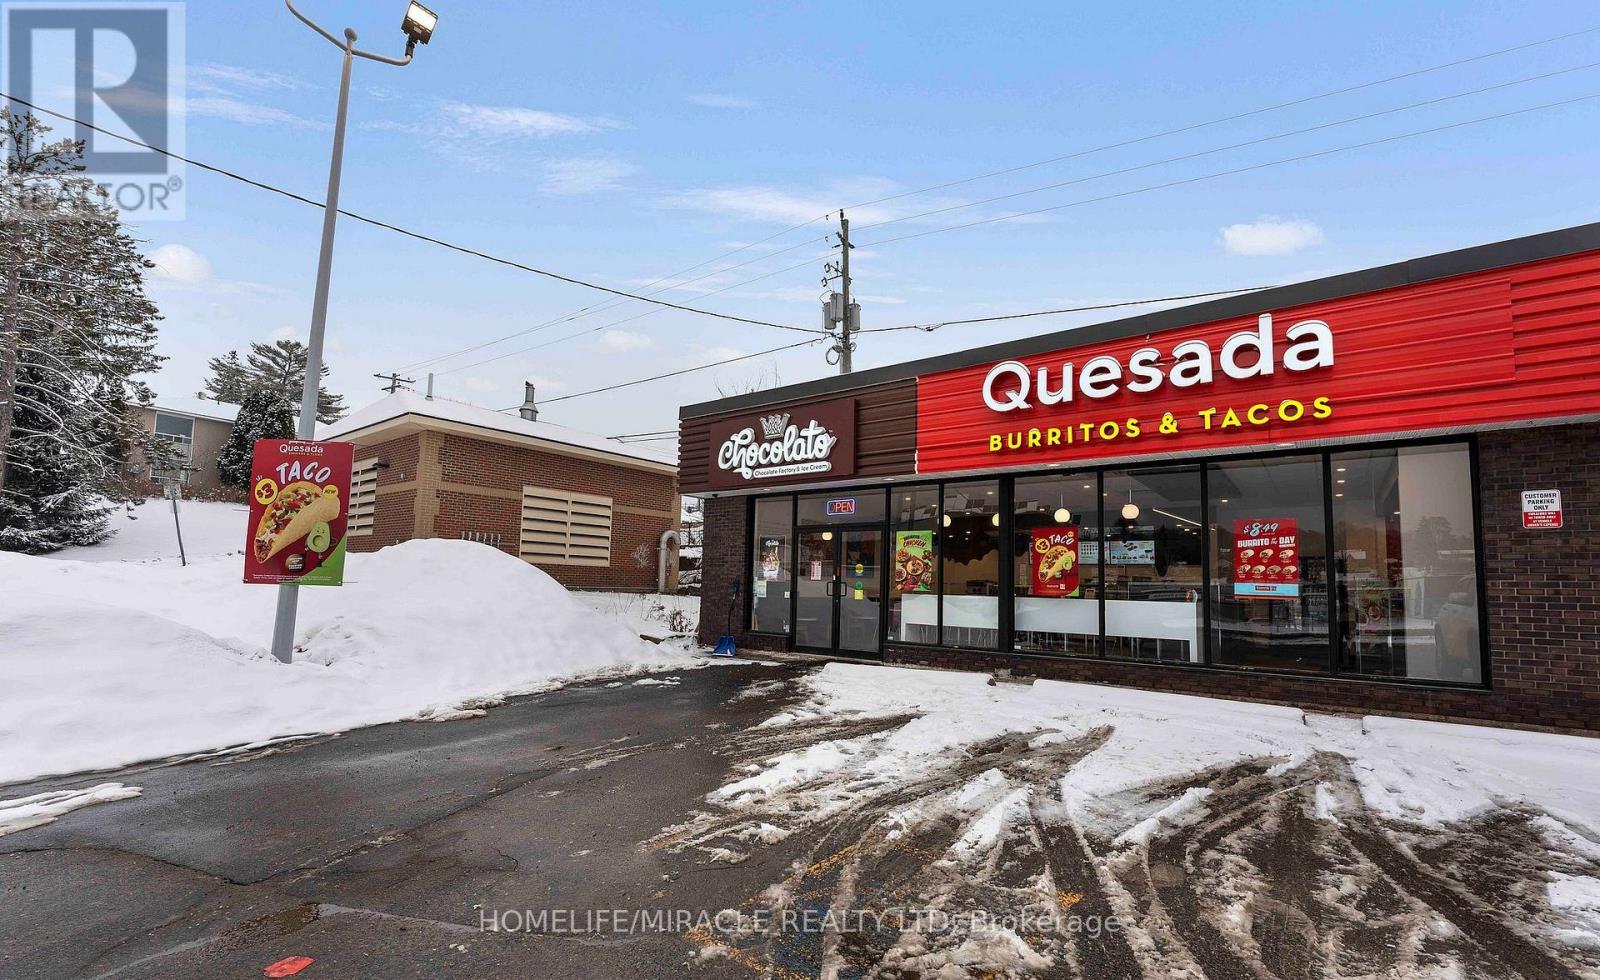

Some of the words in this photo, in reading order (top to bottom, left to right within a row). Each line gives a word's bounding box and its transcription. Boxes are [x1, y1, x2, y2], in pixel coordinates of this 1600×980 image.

[982, 313, 1335, 412] Quesada
[989, 418, 1141, 452] BURRITOS
[1159, 412, 1179, 434] &
[1199, 397, 1332, 430] TACOS
[280, 444, 323, 453] Quesada
[718, 420, 837, 479] Chocolato
[276, 460, 332, 485] TACO
[754, 468, 778, 477] Chocolate
[778, 466, 796, 474] Factory
[256, 483, 274, 499] $3
[1049, 534, 1074, 545] TACO
[1237, 538, 1270, 548] BURRITO
[1279, 536, 1295, 544] DAY
